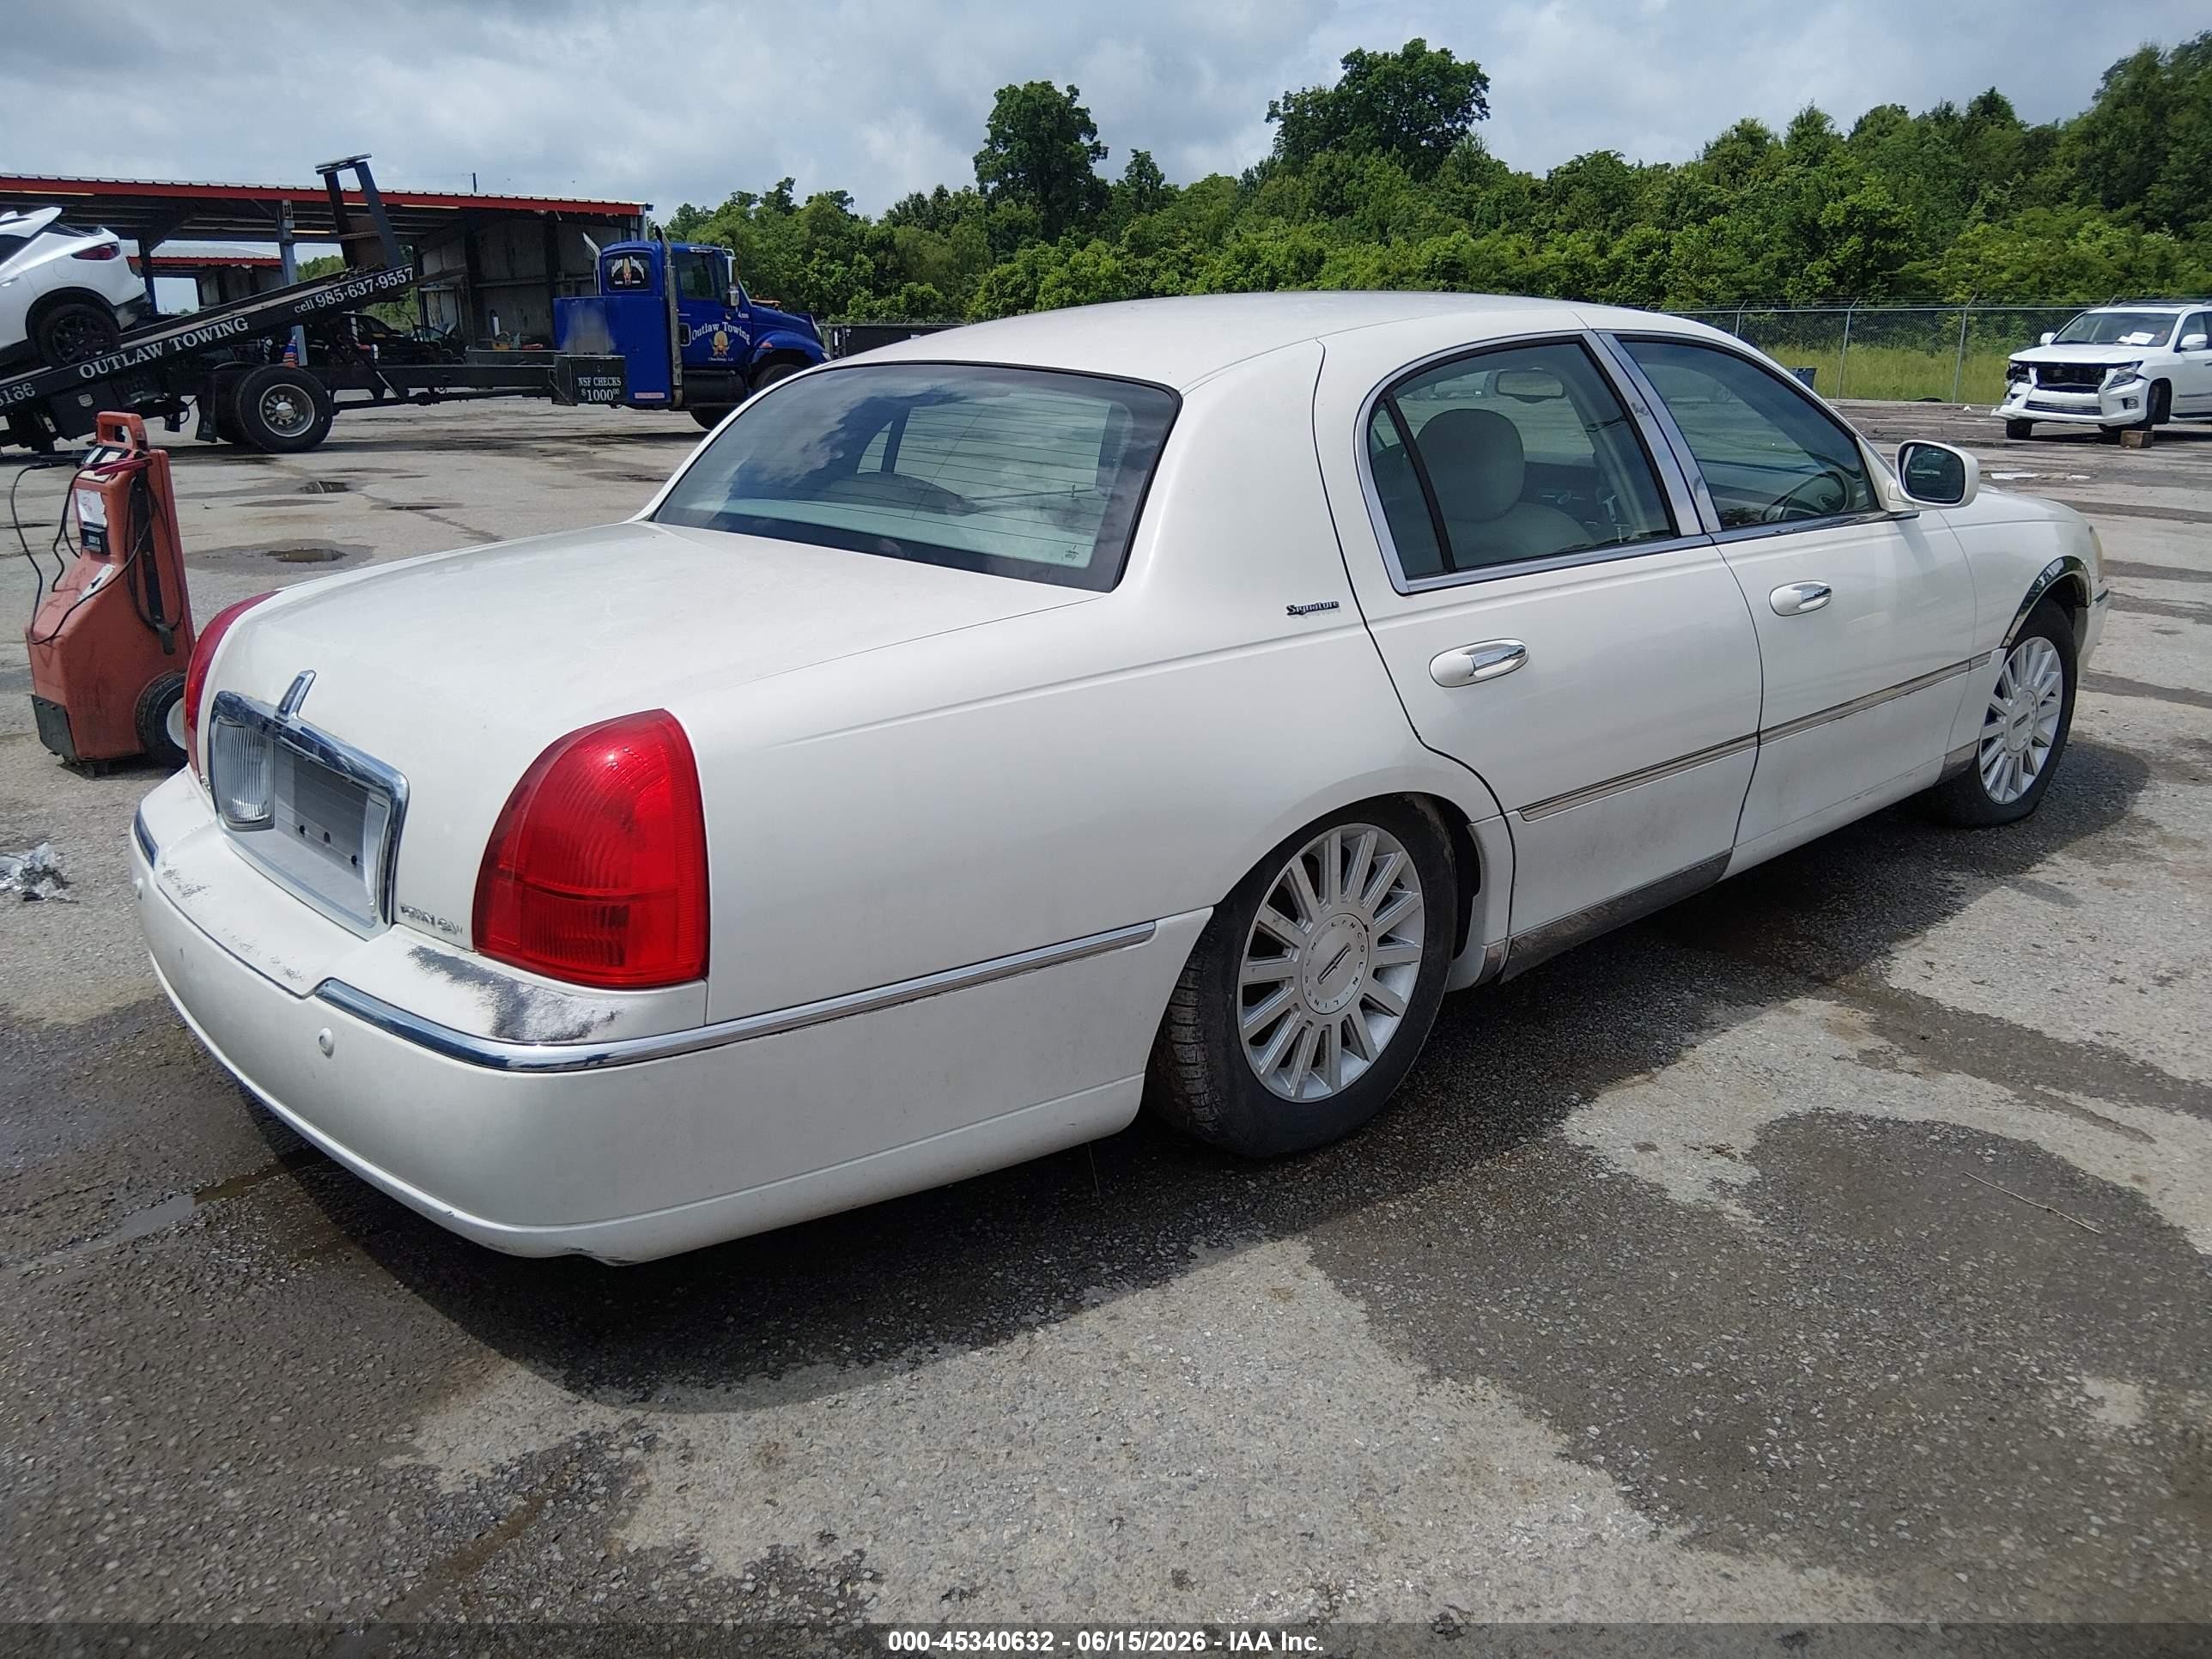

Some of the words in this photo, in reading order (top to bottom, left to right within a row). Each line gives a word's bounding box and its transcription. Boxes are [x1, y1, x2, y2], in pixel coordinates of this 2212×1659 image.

[295, 299, 315, 313] cell
[692, 323, 720, 341] Outlaw
[722, 321, 750, 345] Towing
[79, 343, 164, 379] OUTLAW
[169, 317, 249, 351] TOWING
[578, 377, 592, 386] NSF
[593, 377, 621, 386] CHECKS
[1286, 601, 1340, 616] Signature
